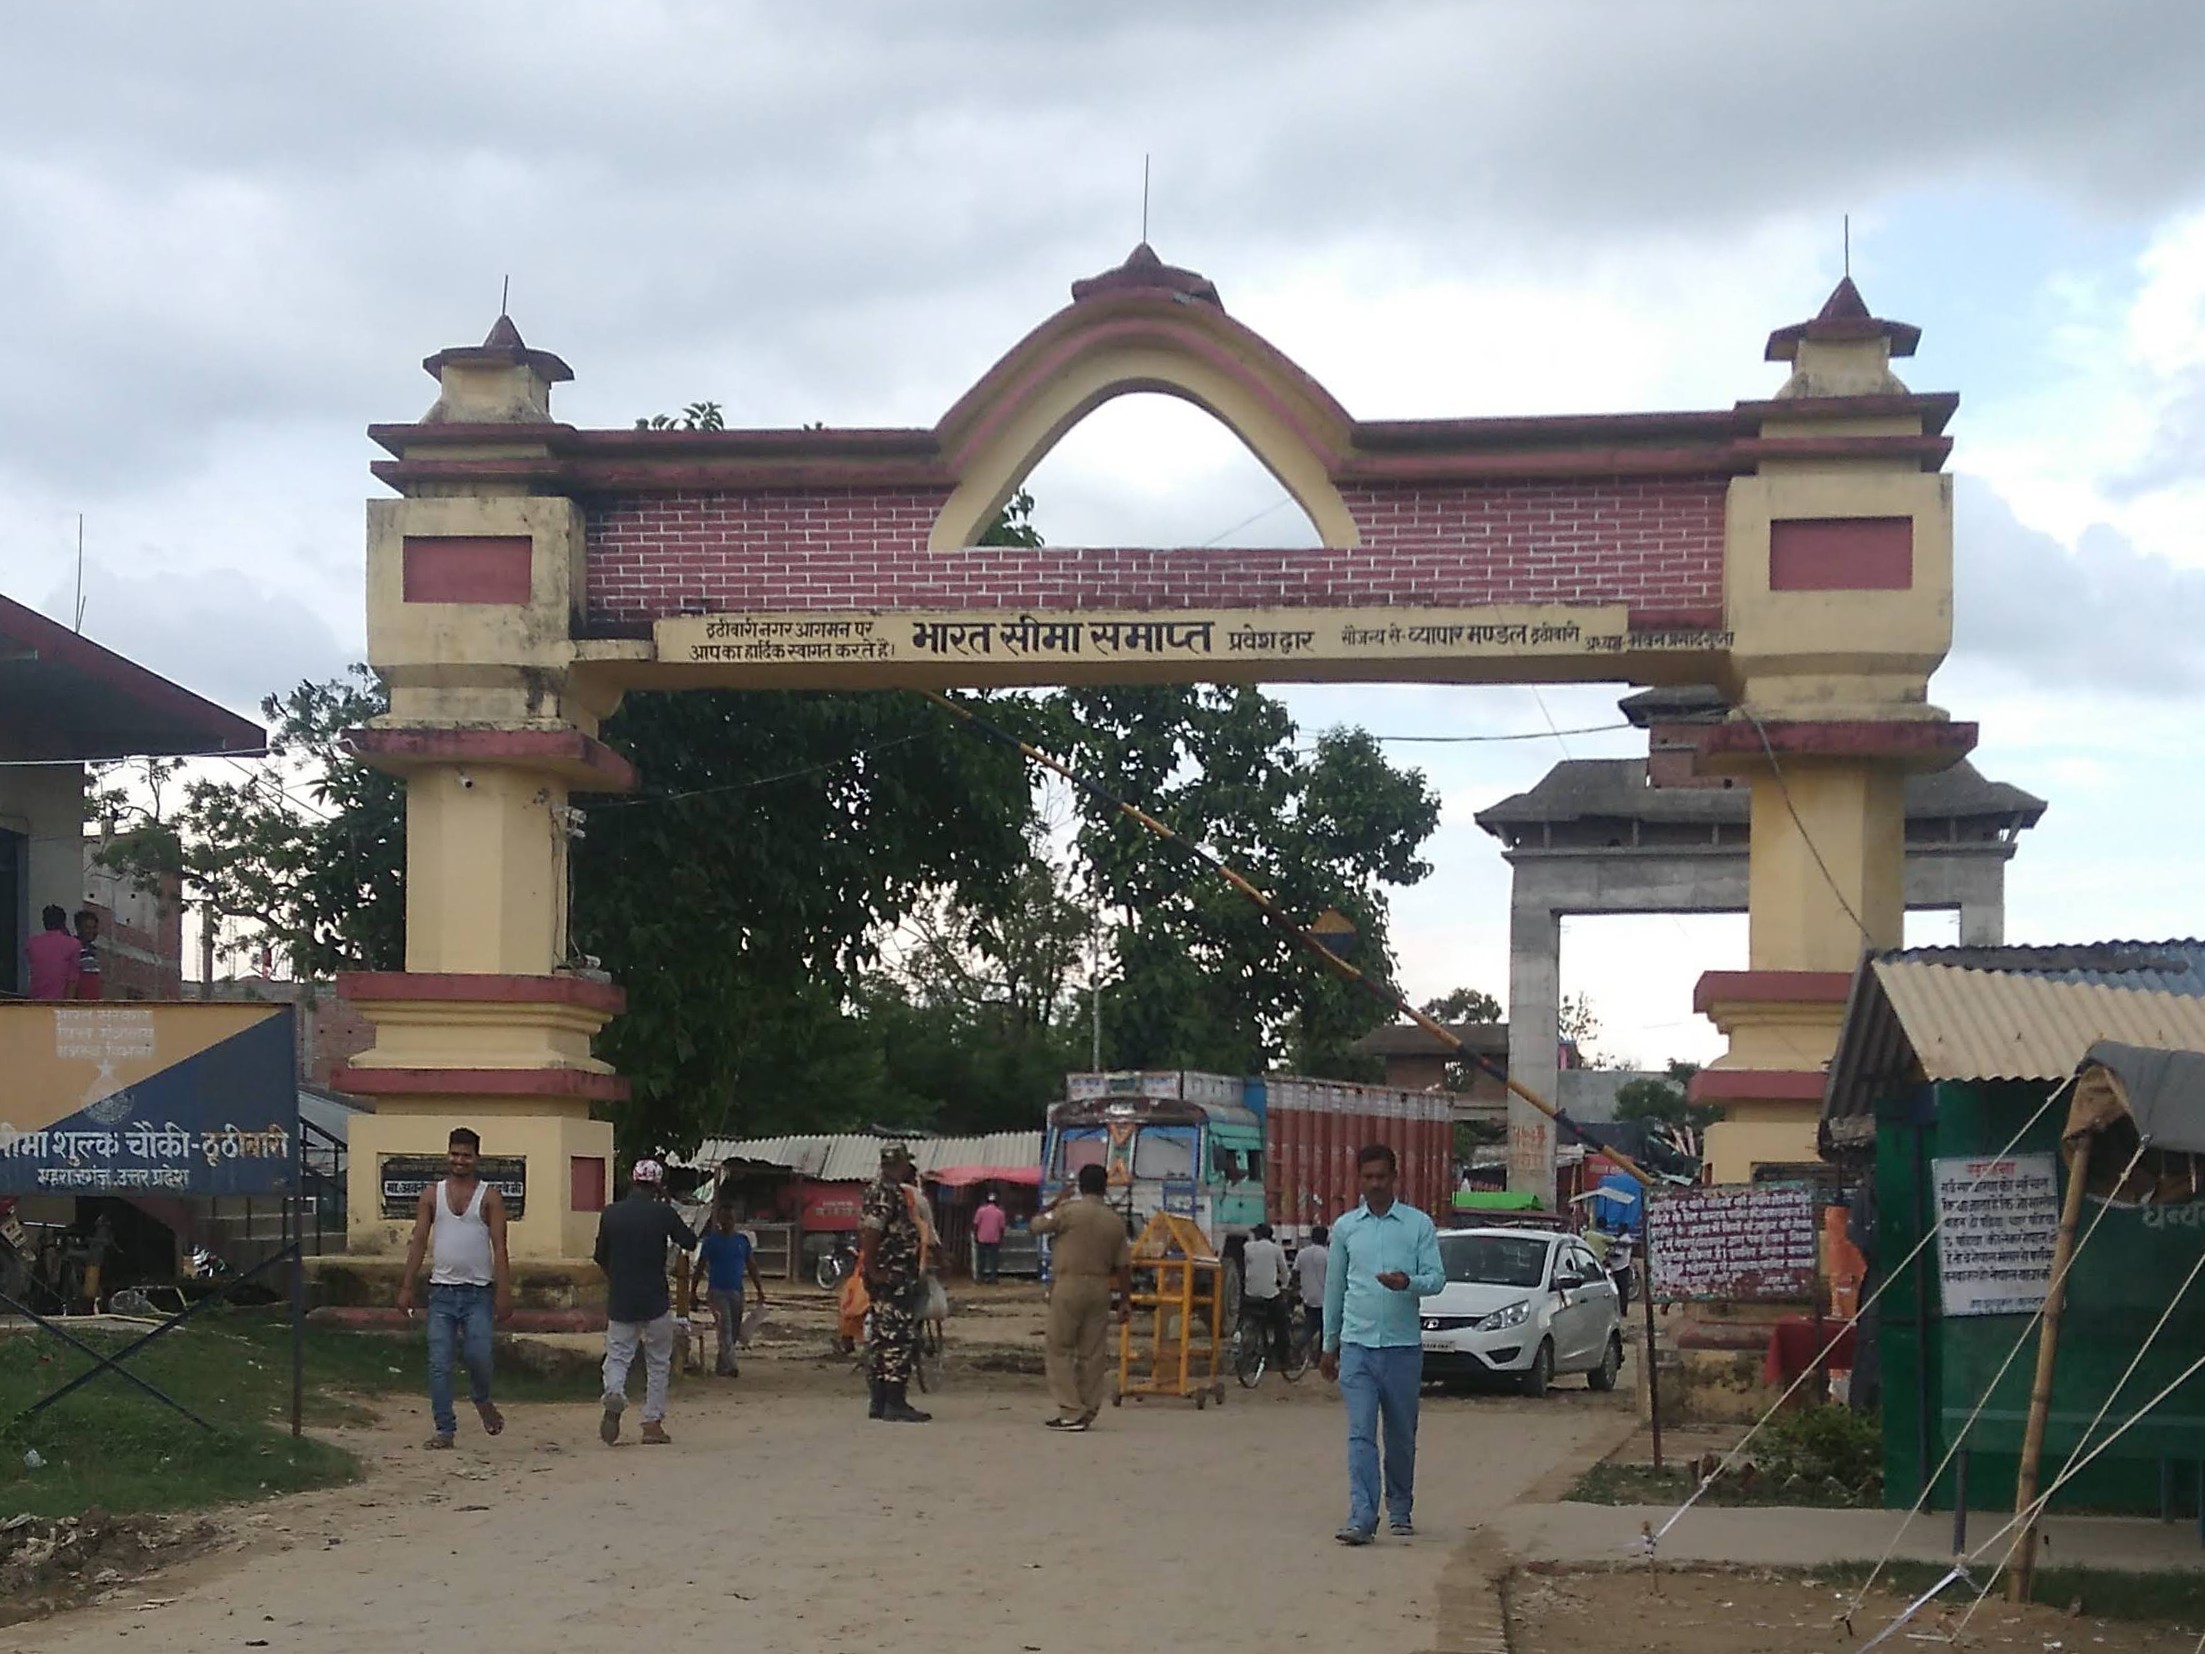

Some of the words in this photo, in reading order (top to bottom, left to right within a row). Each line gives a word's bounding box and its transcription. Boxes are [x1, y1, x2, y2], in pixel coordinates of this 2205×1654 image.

[760, 623, 794, 640] नगर
[795, 622, 852, 638] आगमन
[854, 622, 875, 639] पर
[913, 620, 996, 655] भारत
[1000, 614, 1084, 656] सीमा
[1089, 620, 1215, 655] समाप्त
[1227, 623, 1275, 652] प्रवेश
[1278, 629, 1316, 654] द्वार
[1341, 625, 1387, 645] सौजन्य
[1407, 625, 1466, 646] व्यापार
[1467, 624, 1527, 645] मण्डल
[744, 640, 786, 659] हार्दिक
[788, 643, 832, 660] स्वागत
[836, 639, 877, 659] करते
[52, 1131, 118, 1166] शुल्क
[152, 1163, 189, 1187] प्रदेश
